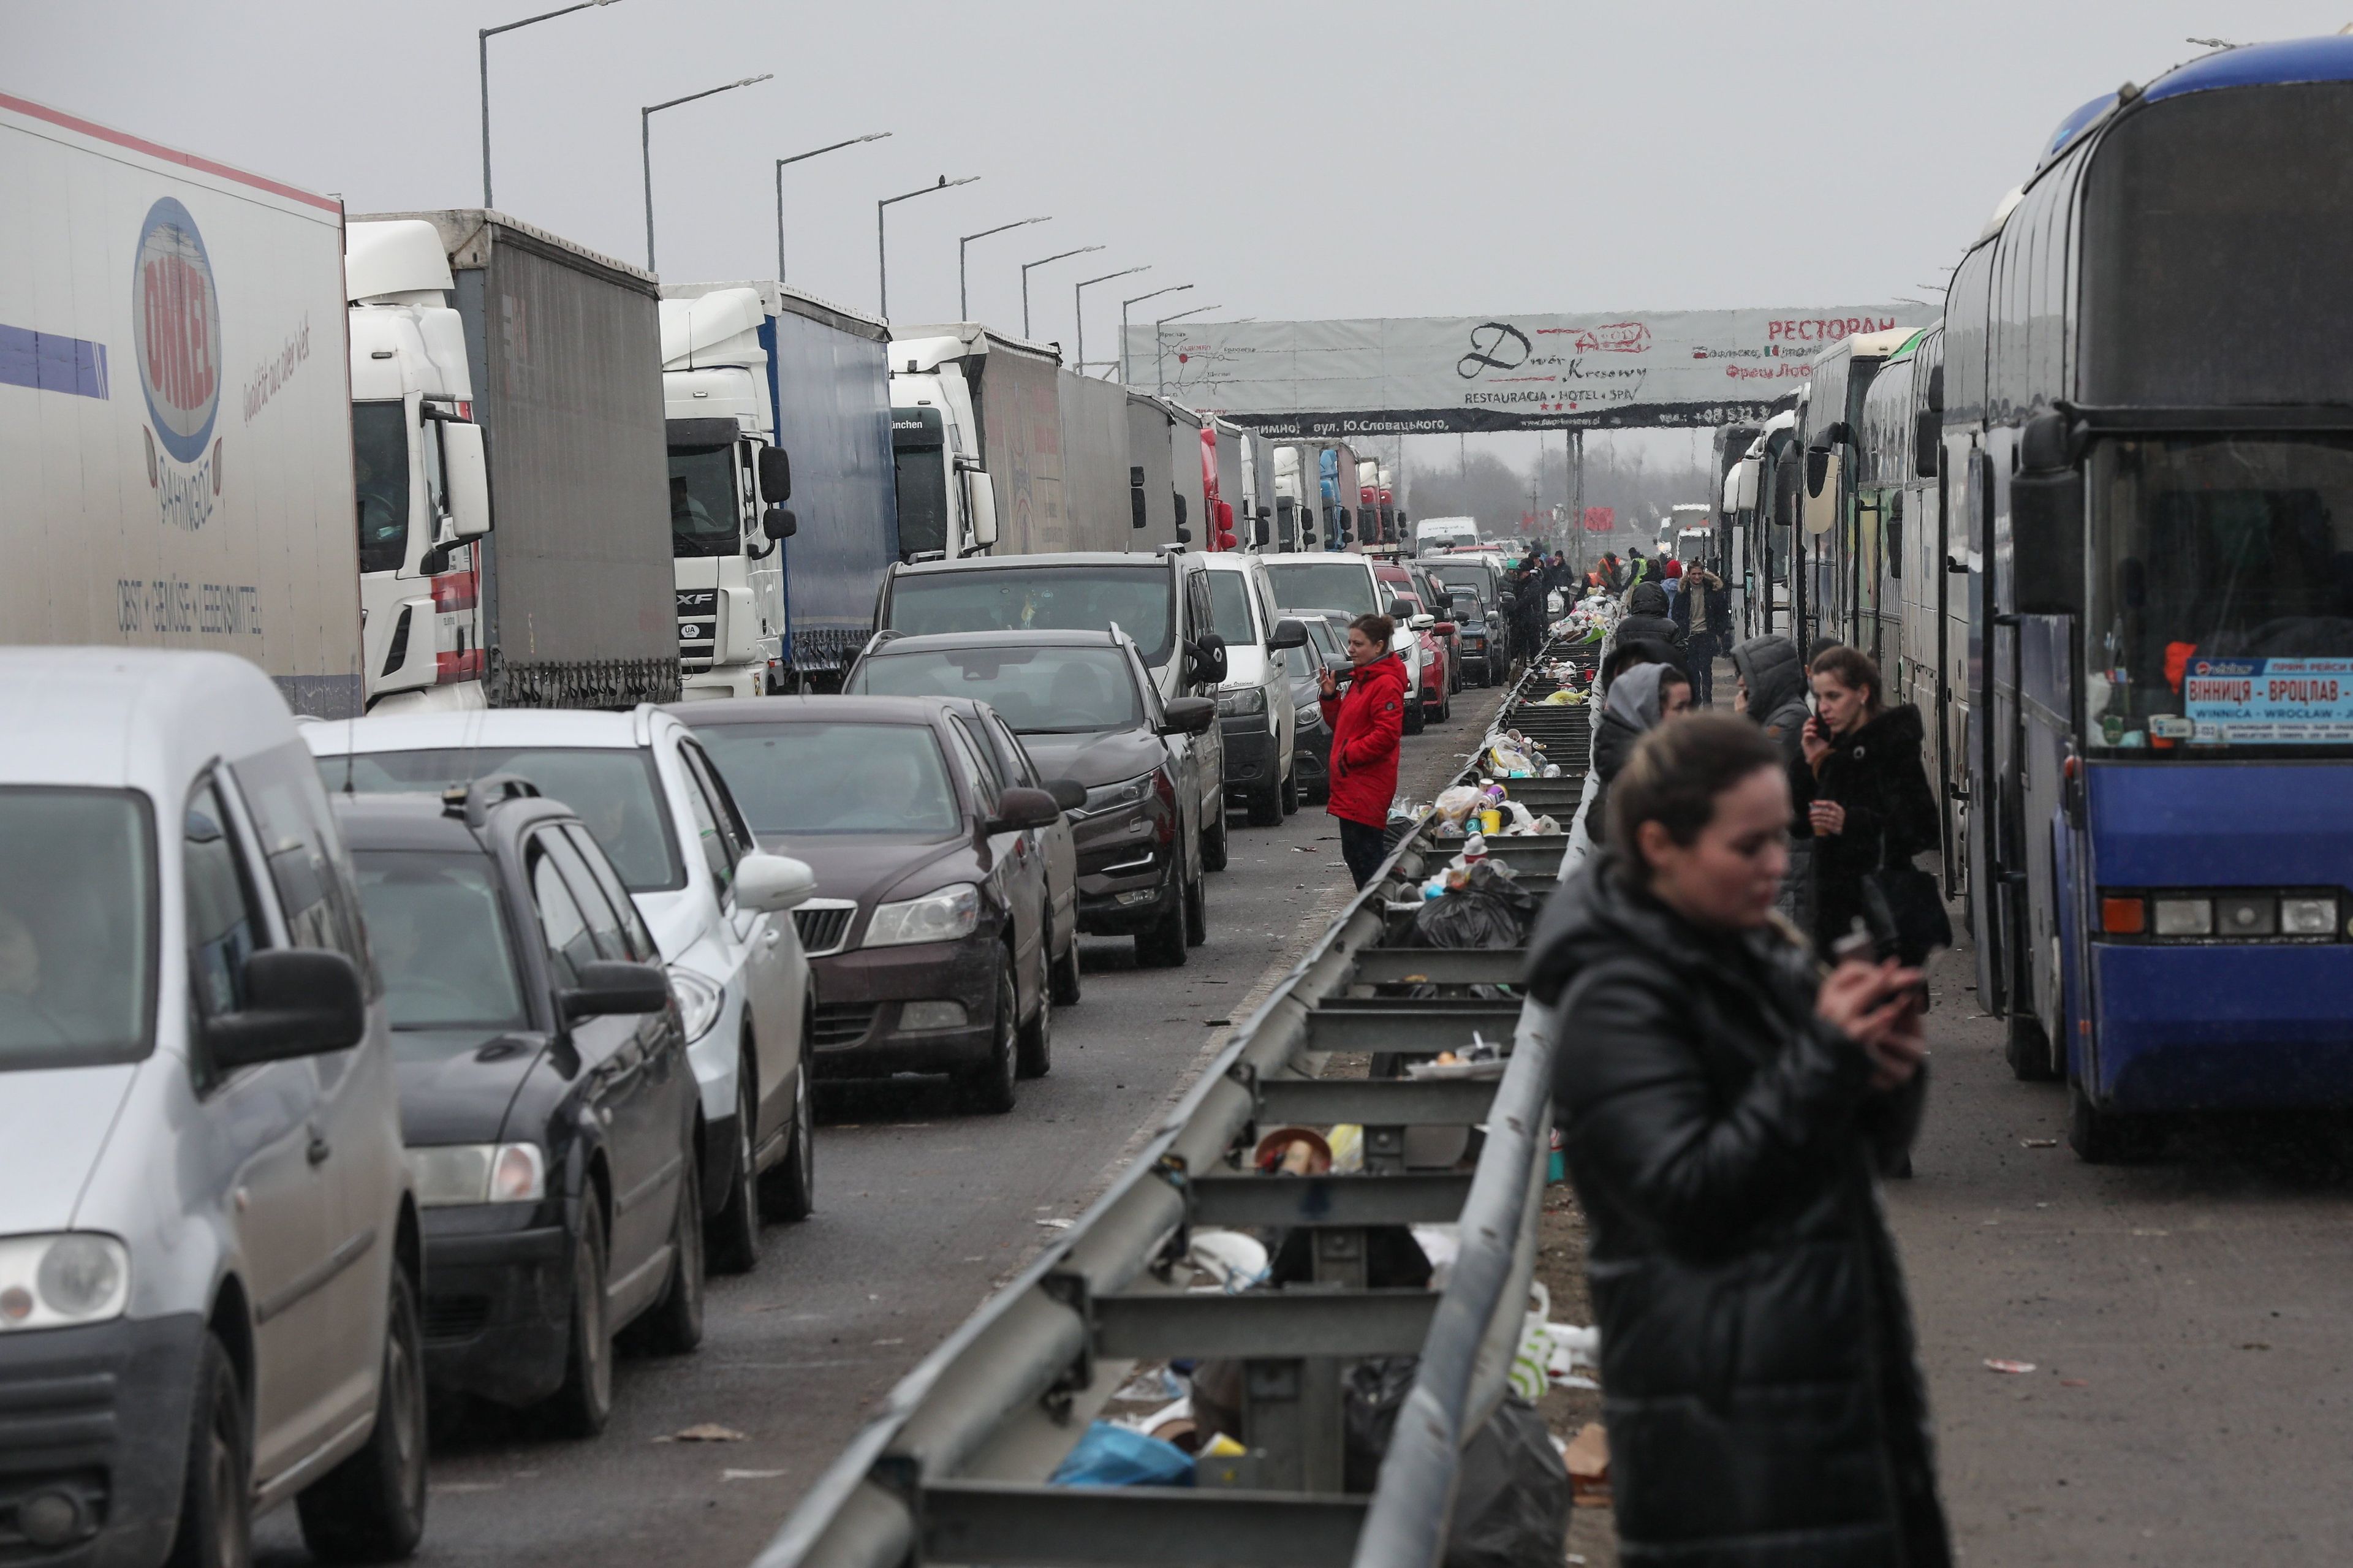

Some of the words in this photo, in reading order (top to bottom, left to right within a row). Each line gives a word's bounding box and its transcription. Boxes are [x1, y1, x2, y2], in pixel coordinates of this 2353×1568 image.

[145, 256, 214, 411] ONKEL
[1768, 317, 1895, 341] РЕСТОРАН
[1465, 390, 1547, 404] RESTAURACJA
[1559, 390, 1597, 400] HOTEL
[1609, 388, 1634, 400] SPA
[1314, 423, 1339, 435] вул.
[1344, 419, 1449, 432] Ю.Словацького,
[117, 579, 142, 632] OBST
[153, 573, 191, 632] GEMÜSE
[676, 594, 713, 605] XF
[2189, 680, 2251, 706] ВІННИЦЯ
[2269, 680, 2338, 706] ВРОЦЛАВ
[2265, 708, 2333, 719] WROCŁAW
